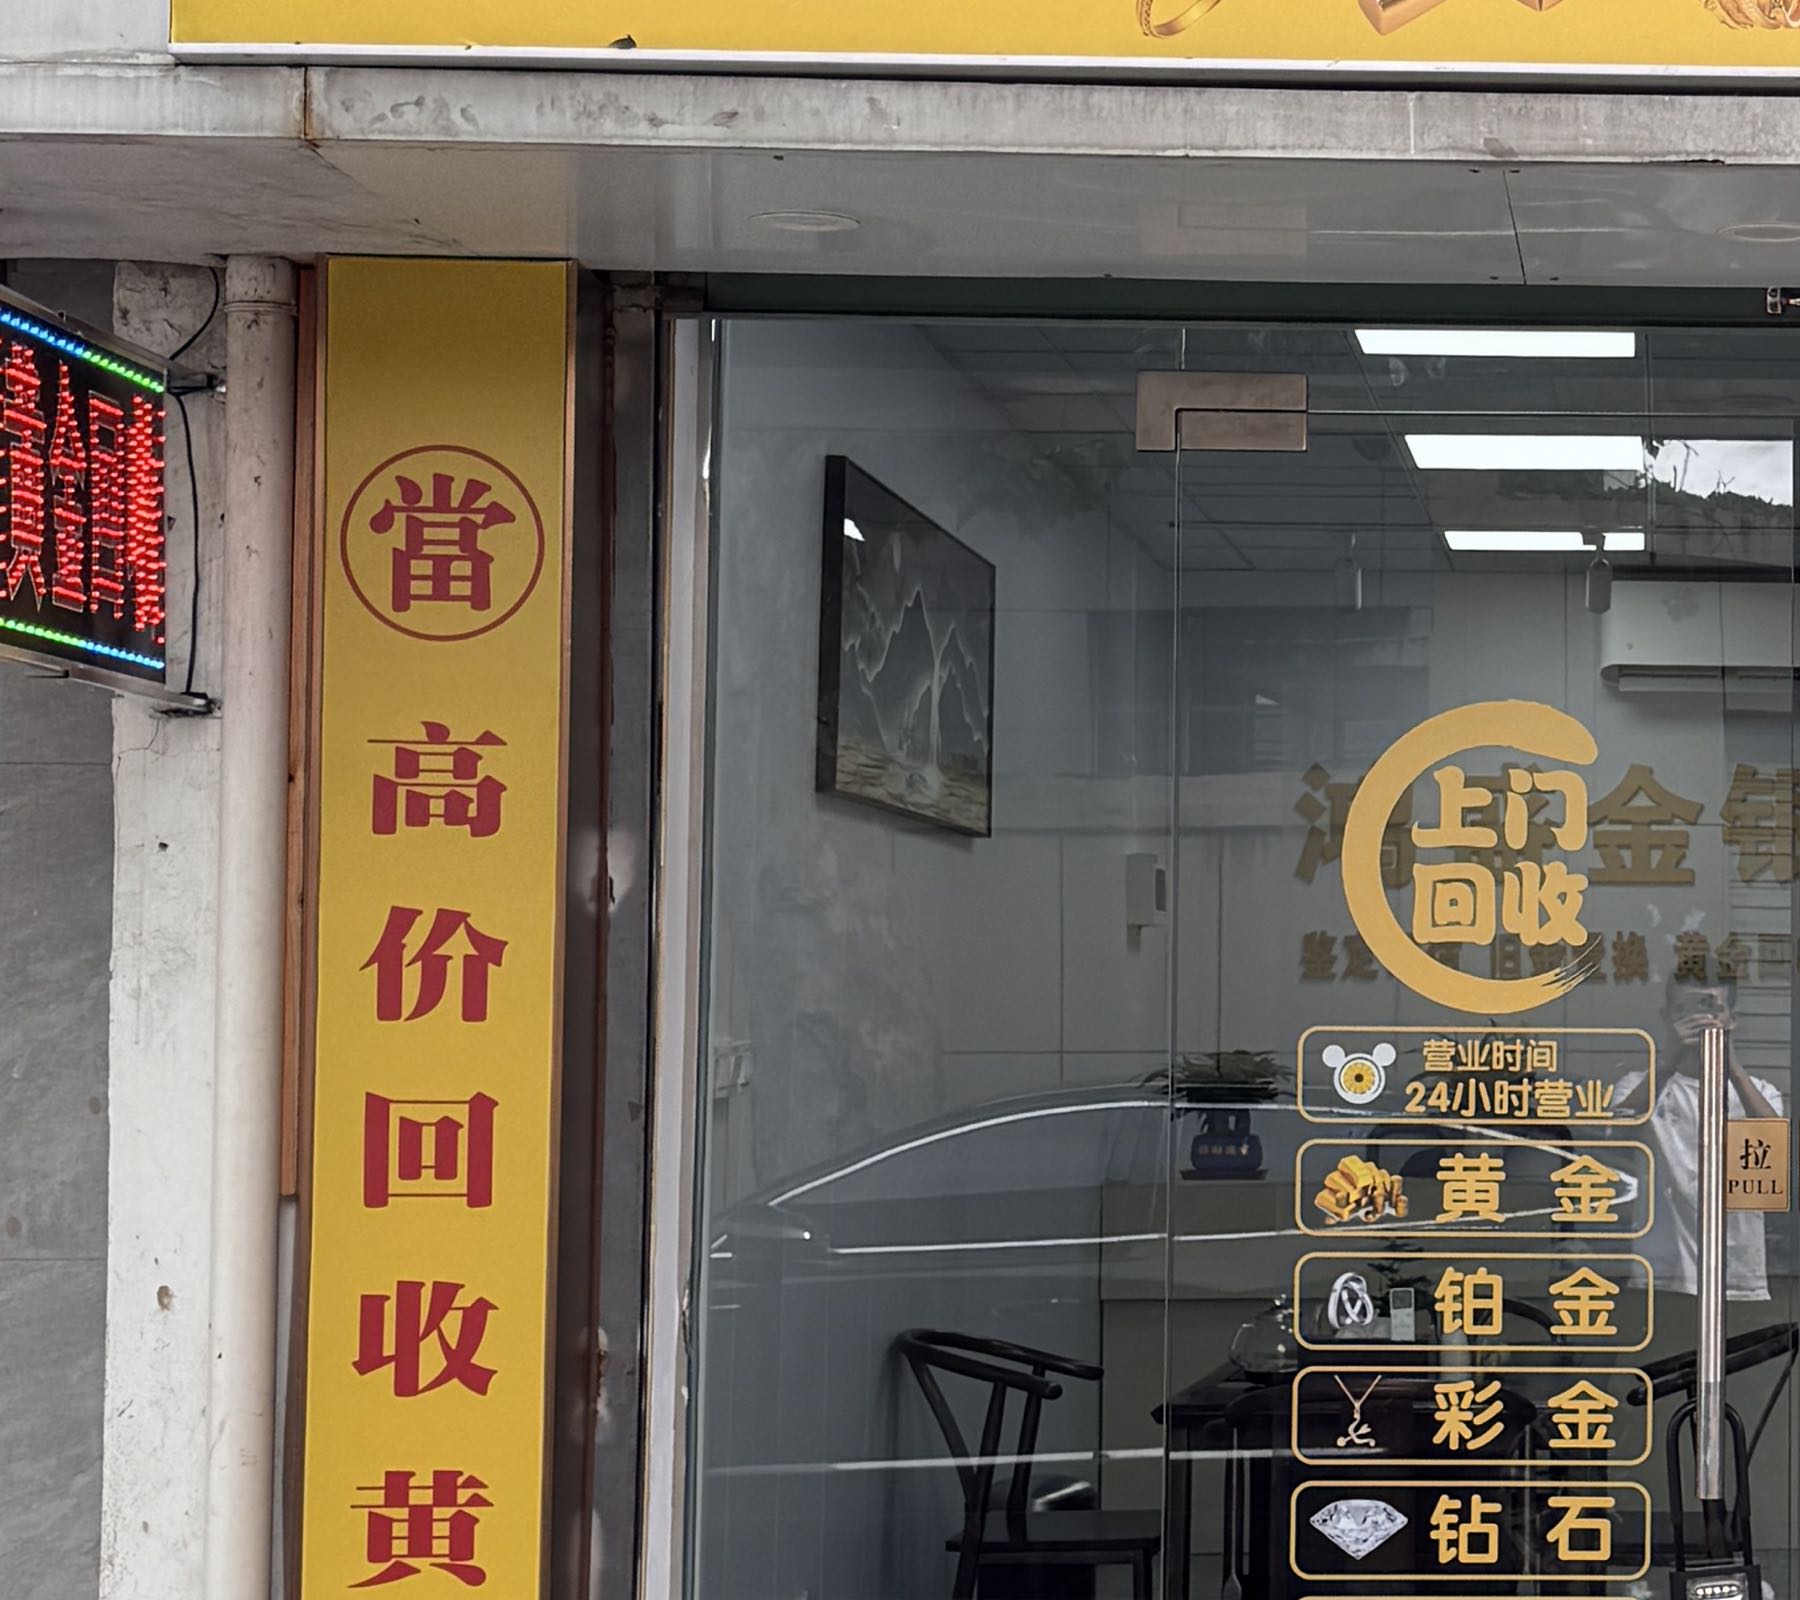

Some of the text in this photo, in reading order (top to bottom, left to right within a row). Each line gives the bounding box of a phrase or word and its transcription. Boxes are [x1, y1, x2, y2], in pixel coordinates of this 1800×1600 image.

[370, 473, 516, 613] 當
[1411, 766, 1589, 852] 上门
[1412, 859, 1590, 946] 回收
[1422, 1038, 1559, 1074] 营业时间
[1404, 1078, 1615, 1119] 24小时营业
[1435, 1153, 1620, 1224] 黄金
[1727, 1178, 1784, 1196] PULL
[1740, 1138, 1772, 1170] 拉
[1433, 1267, 1619, 1336] 铂金
[1432, 1380, 1619, 1451] 彩金
[1429, 1494, 1616, 1565] 钻石
